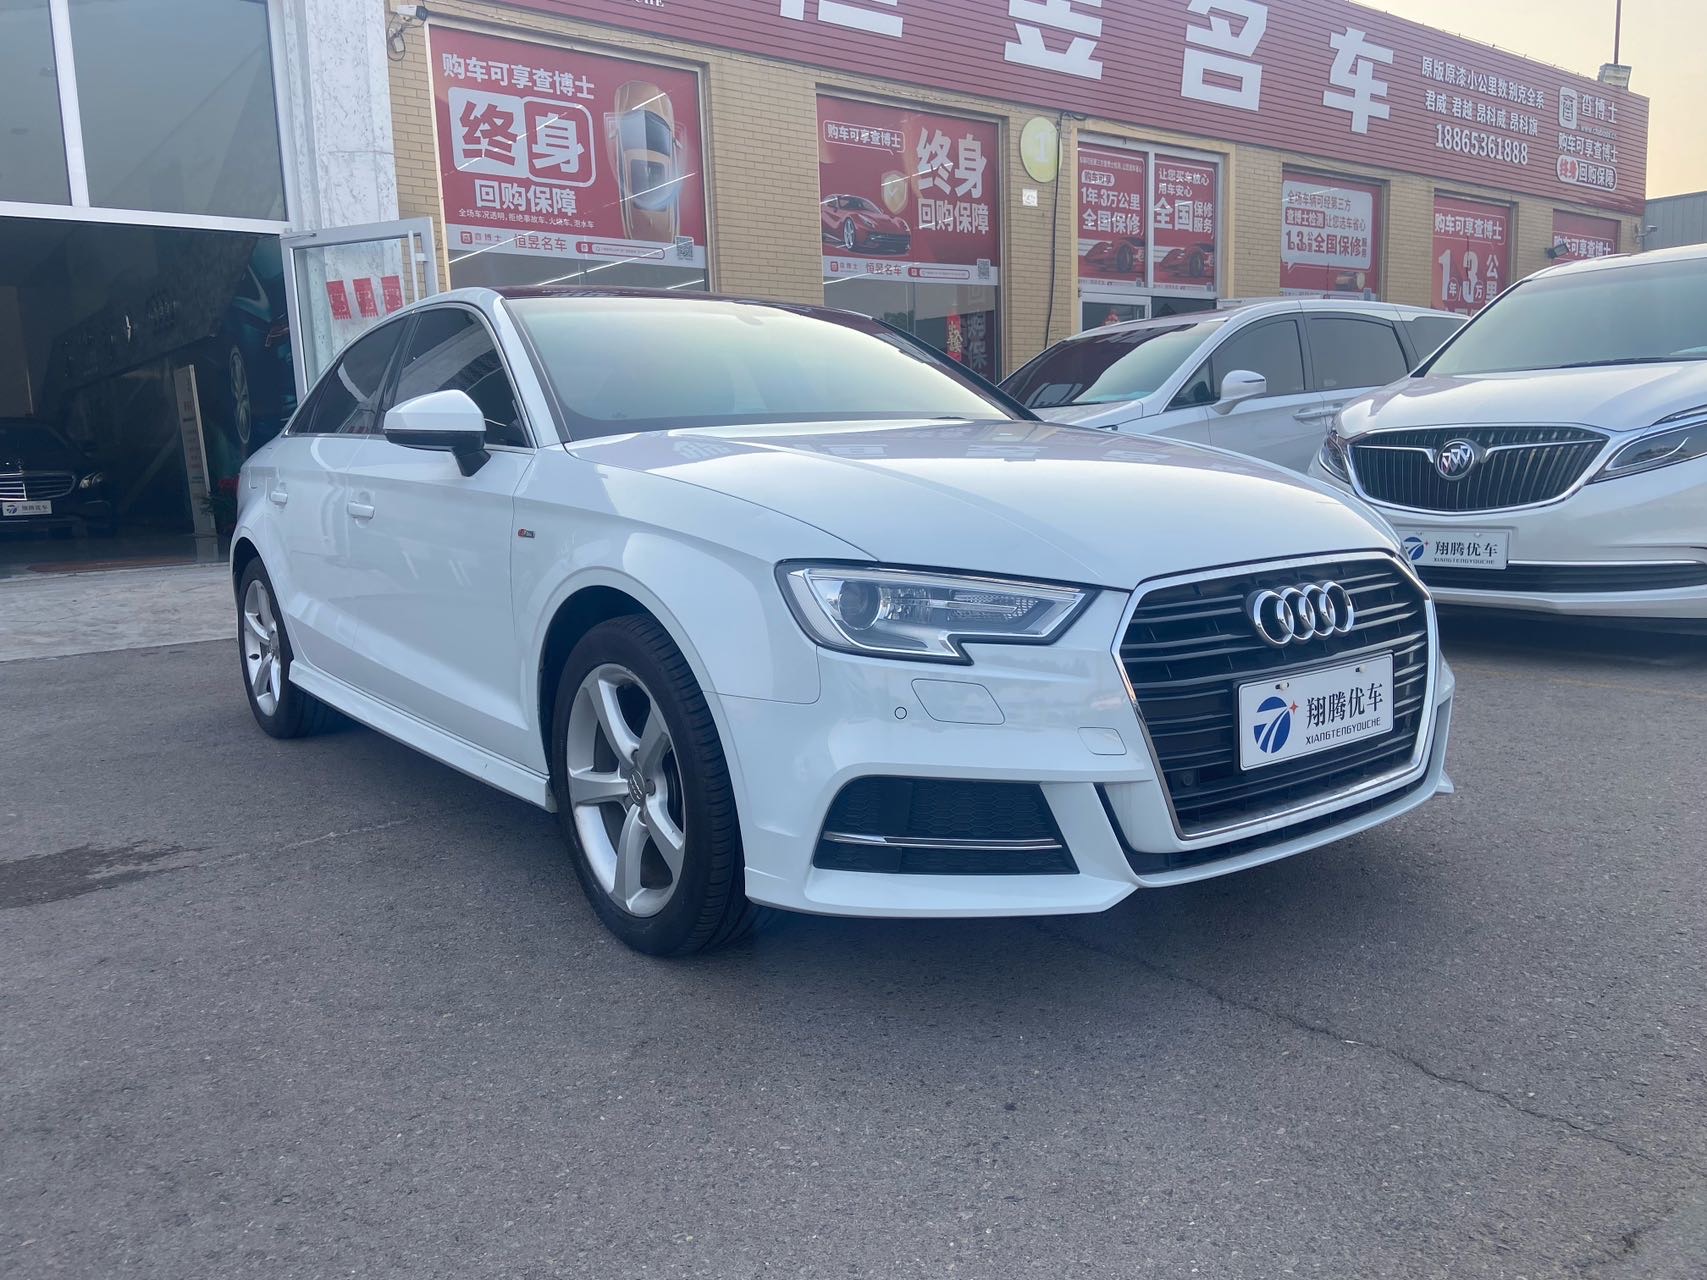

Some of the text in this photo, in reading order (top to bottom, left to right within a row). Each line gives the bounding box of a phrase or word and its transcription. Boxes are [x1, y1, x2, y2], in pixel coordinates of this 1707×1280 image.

[442, 53, 595, 99] 购车可享查博士
[779, 0, 1394, 134] 昱名车
[1421, 56, 1545, 109] 原版原漆小公里数别克全系
[1425, 89, 1538, 137] 君威 君越 昂科威 昂科旗
[1581, 94, 1618, 124] 查博士
[459, 100, 585, 174] 终身
[827, 123, 901, 148] 购车可享查博士
[1435, 124, 1528, 165] 18865361888
[1558, 132, 1618, 163] 购车可享查博士
[916, 127, 987, 199] 终身
[1158, 167, 1210, 186] 让您买车放心
[1579, 163, 1615, 188] 回购保障
[474, 179, 577, 216] 回购保障
[1158, 182, 1193, 198] 用车安心
[918, 198, 989, 235] 回购保障
[1083, 208, 1140, 235] 全国保修
[1154, 196, 1194, 232] 全国
[1194, 201, 1213, 217] 保修
[1193, 217, 1213, 234] 服务
[1434, 213, 1502, 240] 购车可享查博士
[514, 233, 567, 252] 恒昱名车
[1314, 233, 1361, 257] 全国保修
[1435, 541, 1498, 557] 翔腾优车
[1306, 683, 1384, 729] 翔腾优车
[1305, 718, 1381, 745] XIANGTENGYOUCHE
